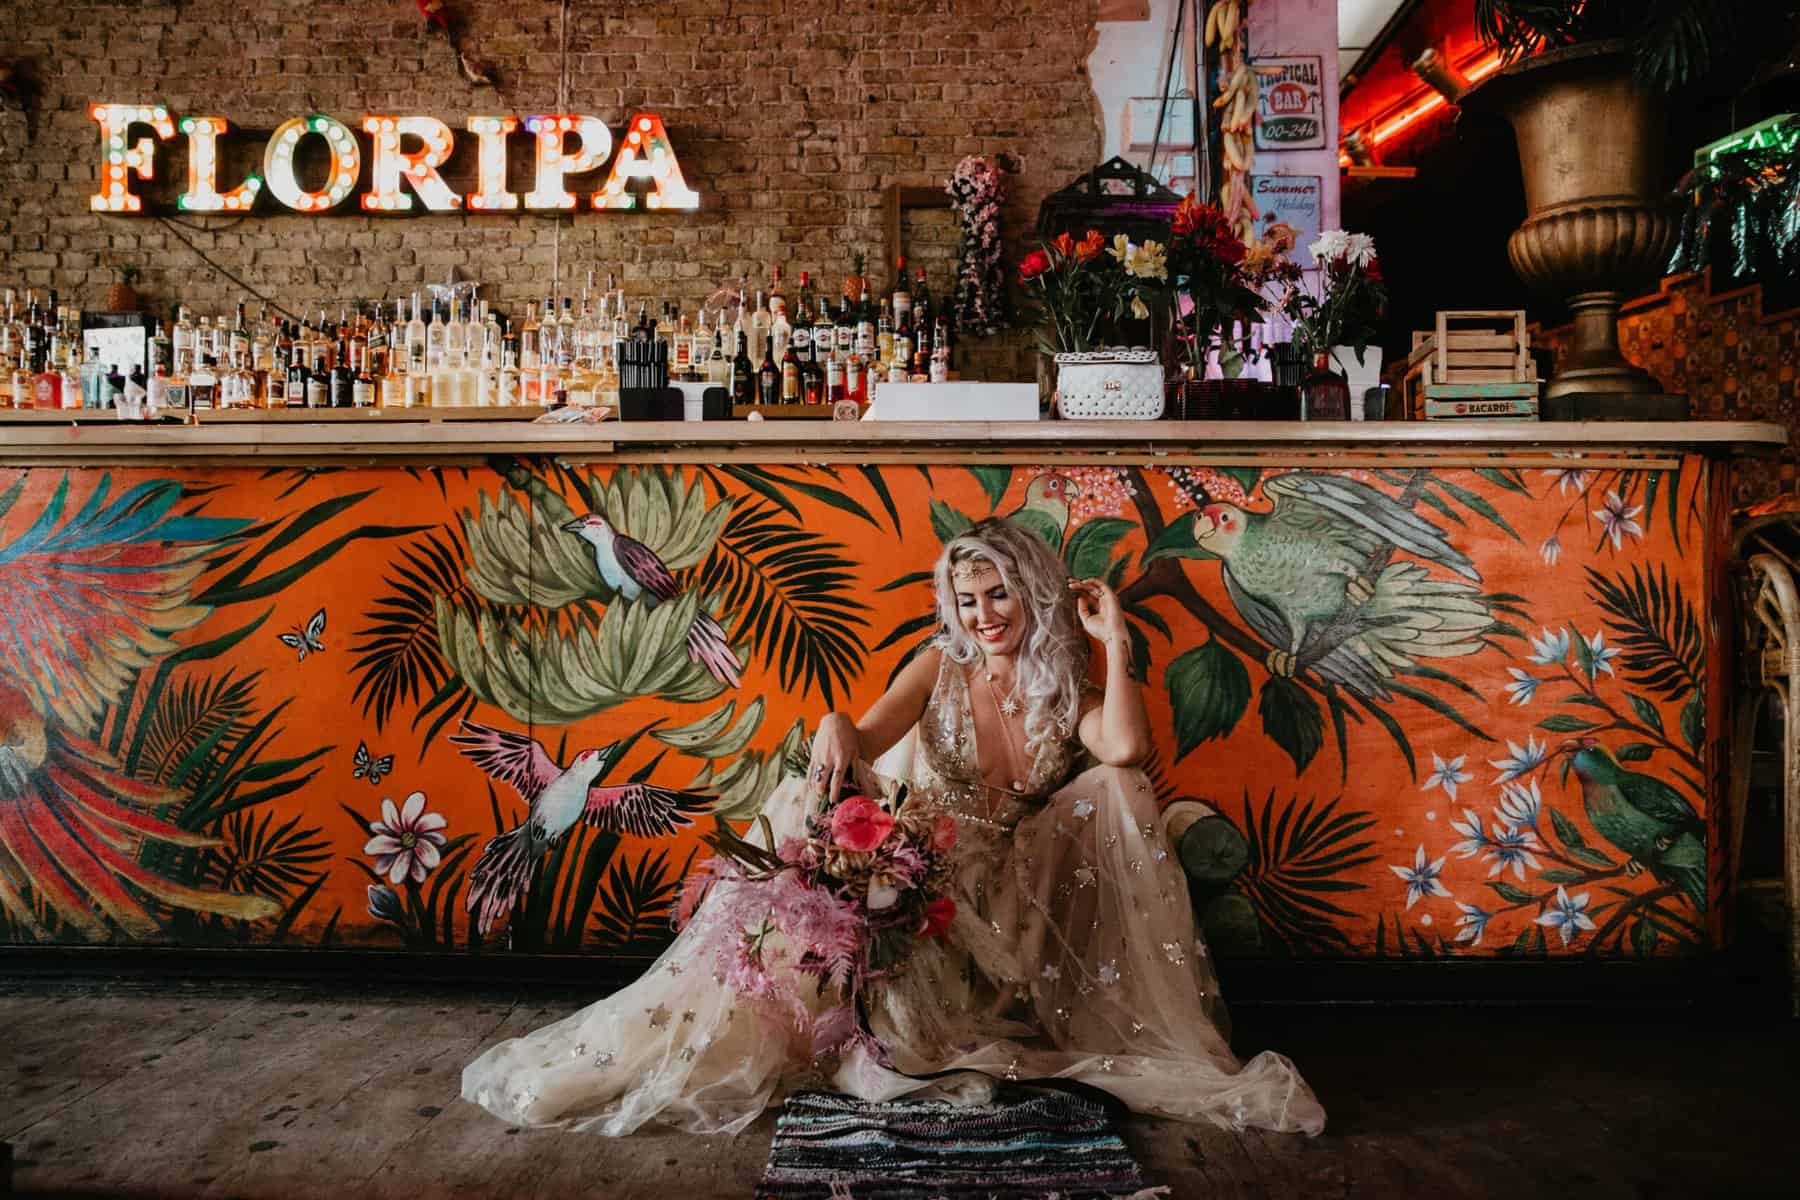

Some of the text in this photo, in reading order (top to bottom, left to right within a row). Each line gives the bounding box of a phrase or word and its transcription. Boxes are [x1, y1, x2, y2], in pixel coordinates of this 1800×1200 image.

[1273, 89, 1304, 110] BAR
[88, 103, 700, 213] FLORIPA
[1257, 178, 1316, 194] Summer
